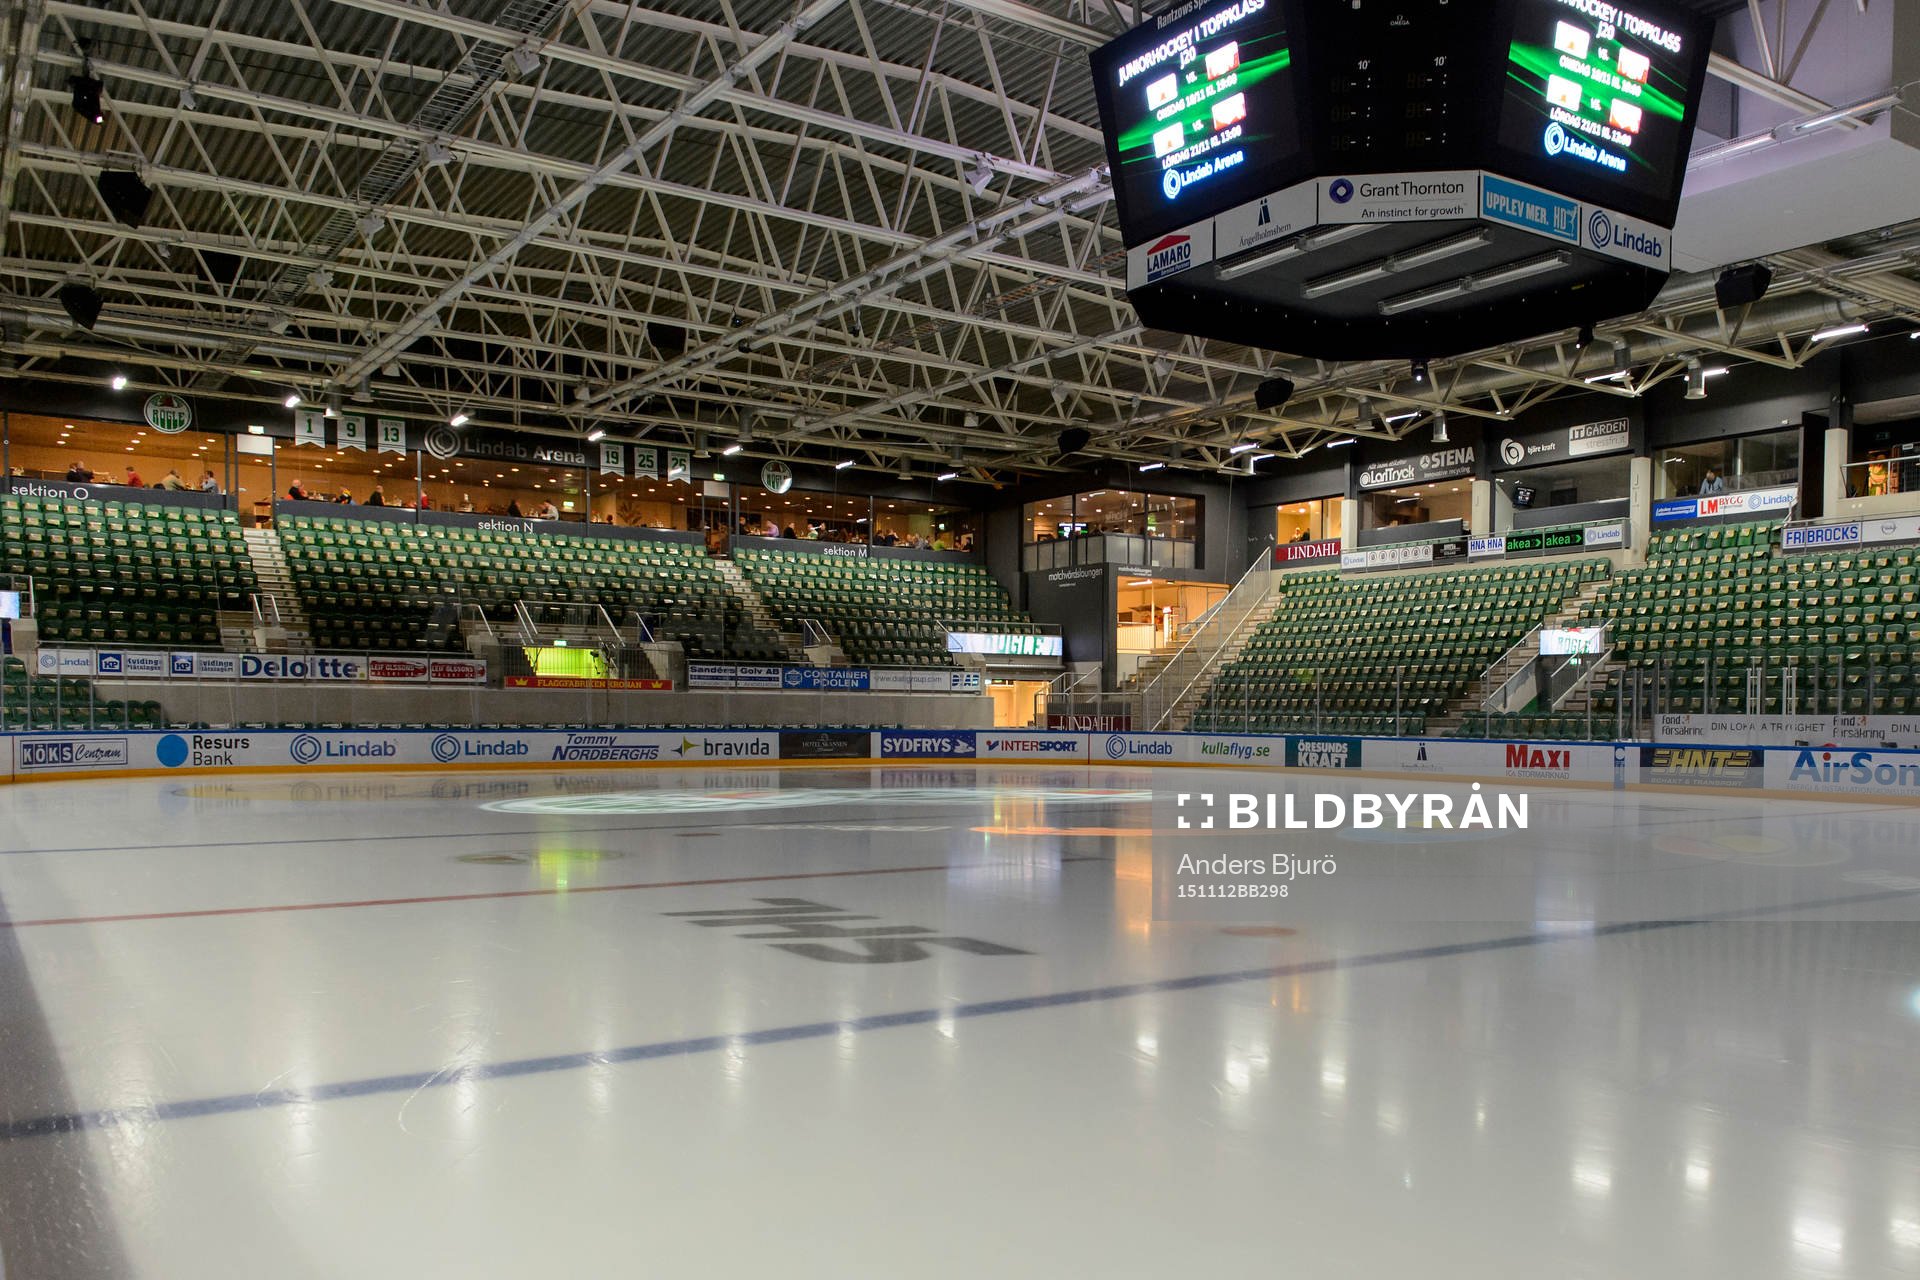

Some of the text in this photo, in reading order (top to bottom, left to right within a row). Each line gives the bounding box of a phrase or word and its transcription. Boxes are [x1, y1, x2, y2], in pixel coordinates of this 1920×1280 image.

[1624, 12, 1682, 53] TOPPKLASS
[1118, 26, 1194, 87] JUNIORHOCKEY
[1200, 0, 1265, 38] TOPPKLASS
[1180, 46, 1197, 69] J20
[1563, 136, 1626, 171] Lindab Arena
[1180, 150, 1244, 187] Lindab Arena
[1360, 181, 1464, 198] Grant Thornton
[1362, 205, 1464, 218] An instinct for growth
[1486, 191, 1524, 218] UPPLEV
[1526, 202, 1549, 226] MER.
[1614, 225, 1662, 258] Lindab
[1147, 241, 1191, 273] LAMARO
[306, 418, 313, 433] 1
[346, 422, 356, 438] 9
[384, 426, 400, 442] 13
[464, 438, 585, 464] Lindab Arena
[605, 450, 620, 465] 19
[1431, 447, 1475, 469] STENA
[638, 454, 654, 469] 25
[11, 486, 89, 501] sektion O
[1763, 494, 1793, 505] Lindab
[1700, 499, 1718, 515] LM
[478, 519, 534, 534] sektion N
[1597, 529, 1620, 539] Lindab
[1470, 539, 1486, 551] HNA
[1487, 537, 1503, 549] HNA
[1507, 540, 1531, 550] akea
[1546, 535, 1571, 546] akea
[823, 546, 868, 557] sektion M
[1287, 542, 1339, 561] LINDAHL
[104, 661, 118, 669] KP
[176, 662, 190, 671] KP
[740, 667, 762, 675] Golv
[804, 669, 868, 679] CONTAINER
[1711, 723, 1727, 731] DIN
[1891, 724, 1911, 733] DIN
[193, 735, 250, 750] Resurs
[566, 734, 617, 746] Tommy
[704, 738, 770, 756] bravida
[883, 738, 951, 754] SYDFRYS
[1001, 740, 1078, 753] INTERSPORT
[1297, 739, 1348, 754] ÖRESUNDS
[23, 743, 74, 764] KÖKS
[326, 740, 396, 757] Lindab
[464, 740, 529, 756] Lindab
[552, 746, 660, 761] NORDBERGHS
[1129, 741, 1172, 755] Lindab
[1201, 742, 1270, 759] kullaflyg.se
[193, 752, 234, 766] Bank
[1298, 753, 1348, 768] KRAFT
[1518, 770, 1570, 780] STORMARKNAD
